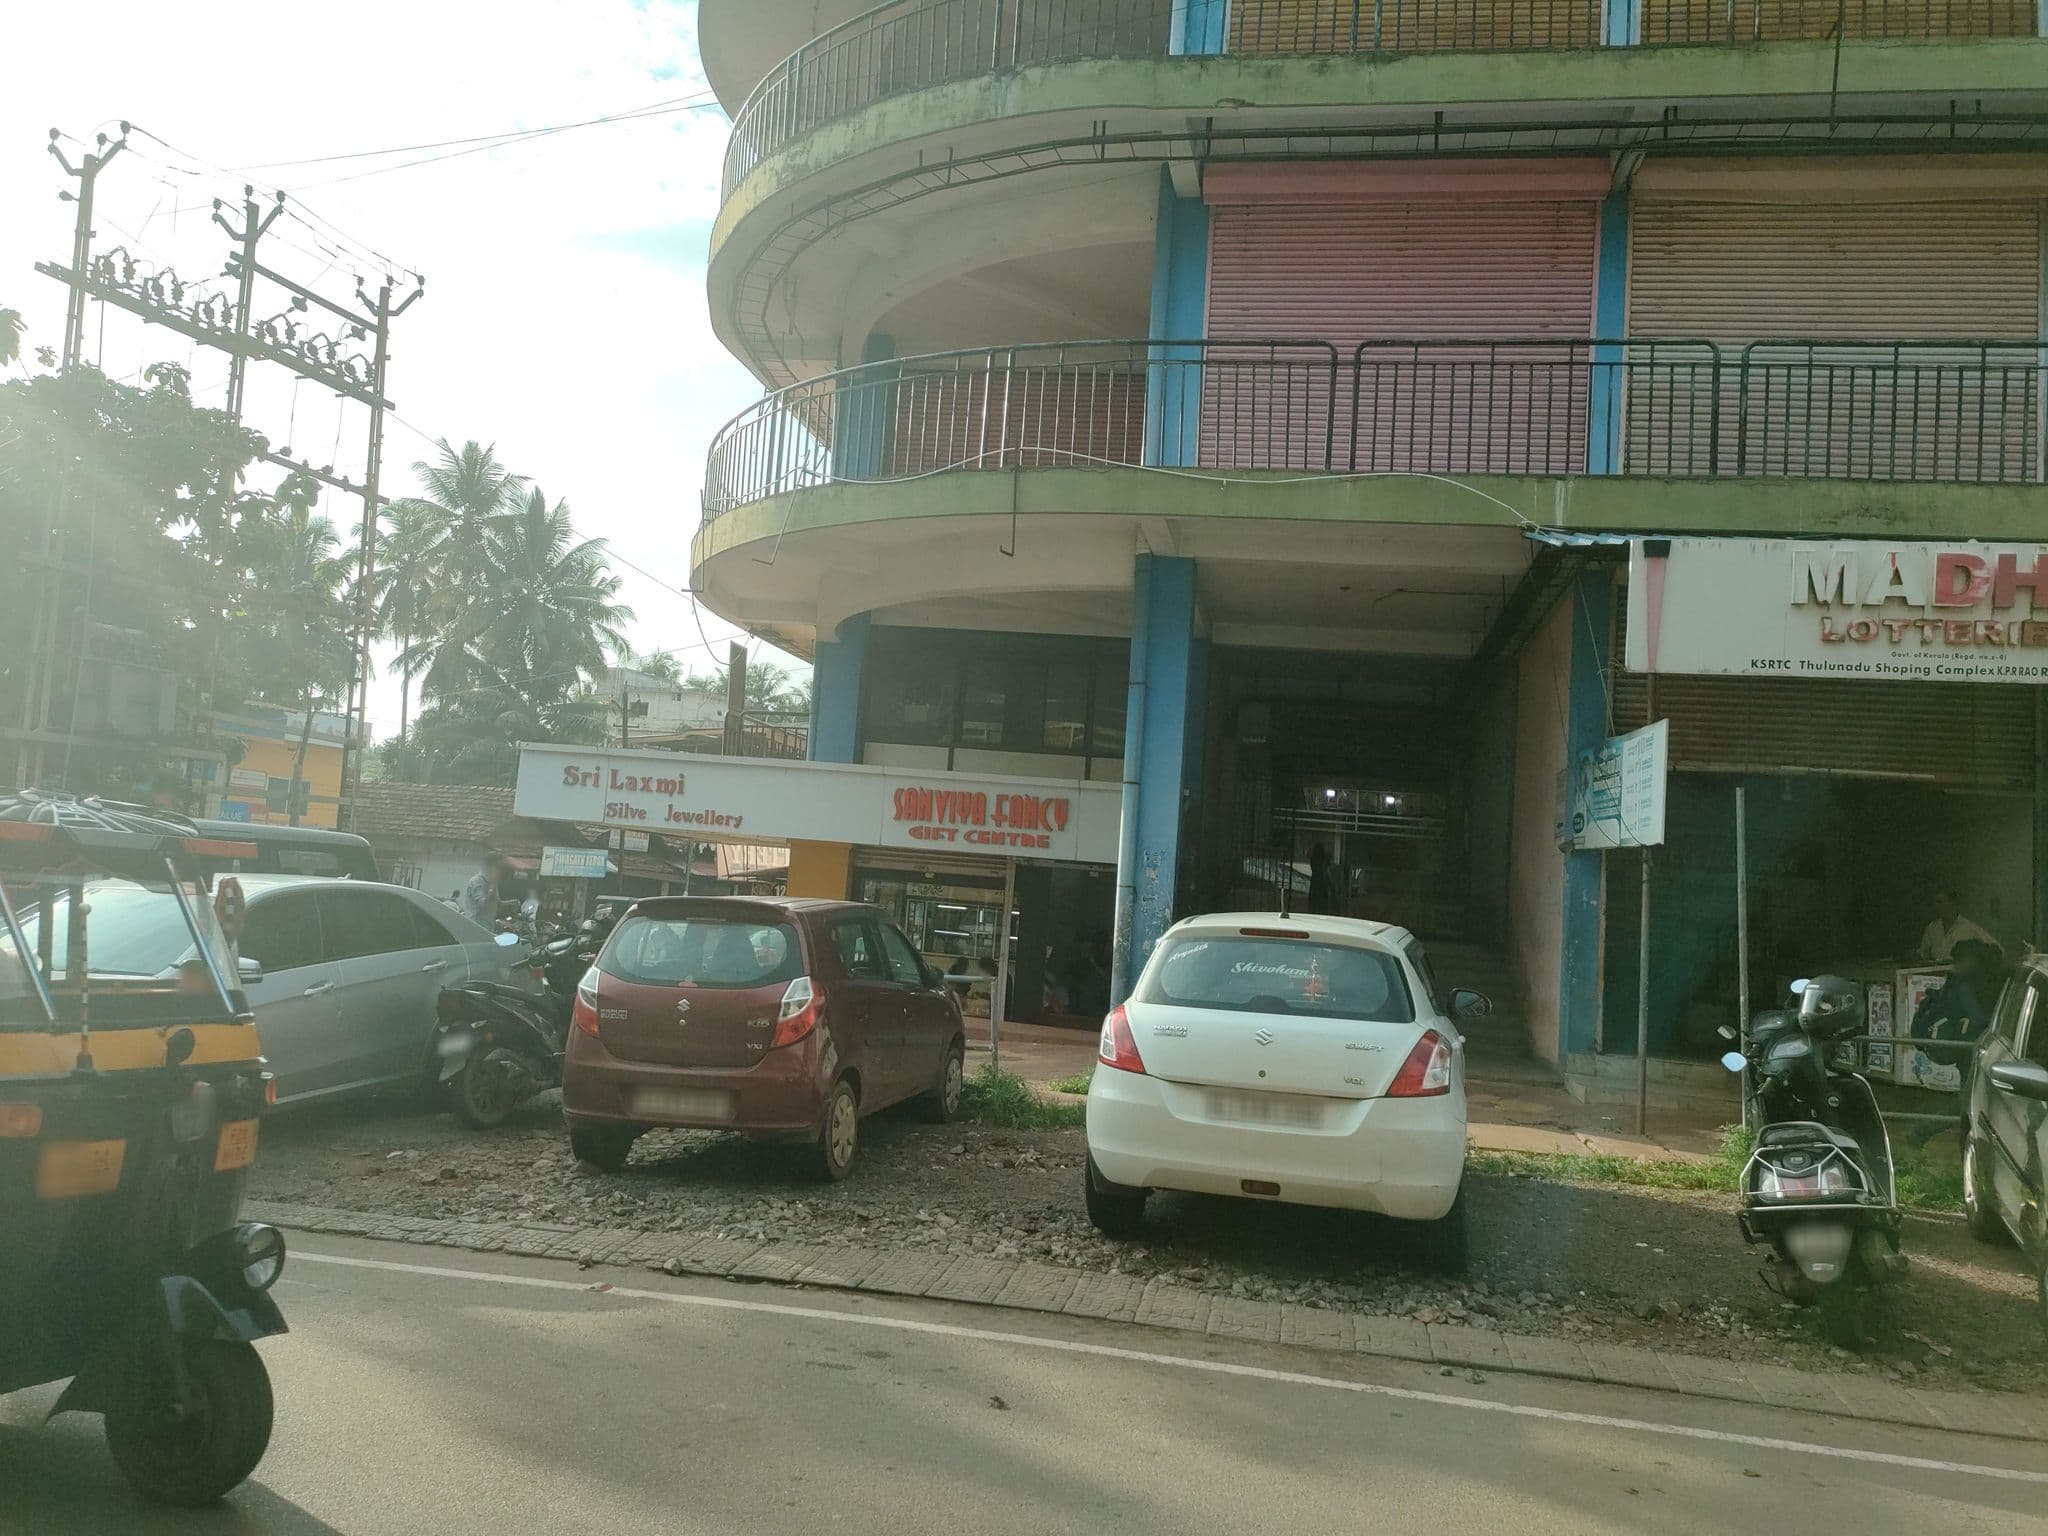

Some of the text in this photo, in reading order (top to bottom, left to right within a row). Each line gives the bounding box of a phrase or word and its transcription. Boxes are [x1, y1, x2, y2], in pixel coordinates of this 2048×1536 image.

[1791, 550, 2048, 609] MADH
[1751, 659, 1791, 670] KSRTC
[1800, 660, 1871, 672] Thulunadu
[1875, 663, 1931, 676] Shoping
[1936, 664, 1995, 677] Complex
[562, 765, 685, 797] Sri Laxmi
[606, 802, 743, 829] Silve Jewellery
[991, 793, 1069, 832] FANCY
[908, 825, 1051, 849] GIFT CENTRE
